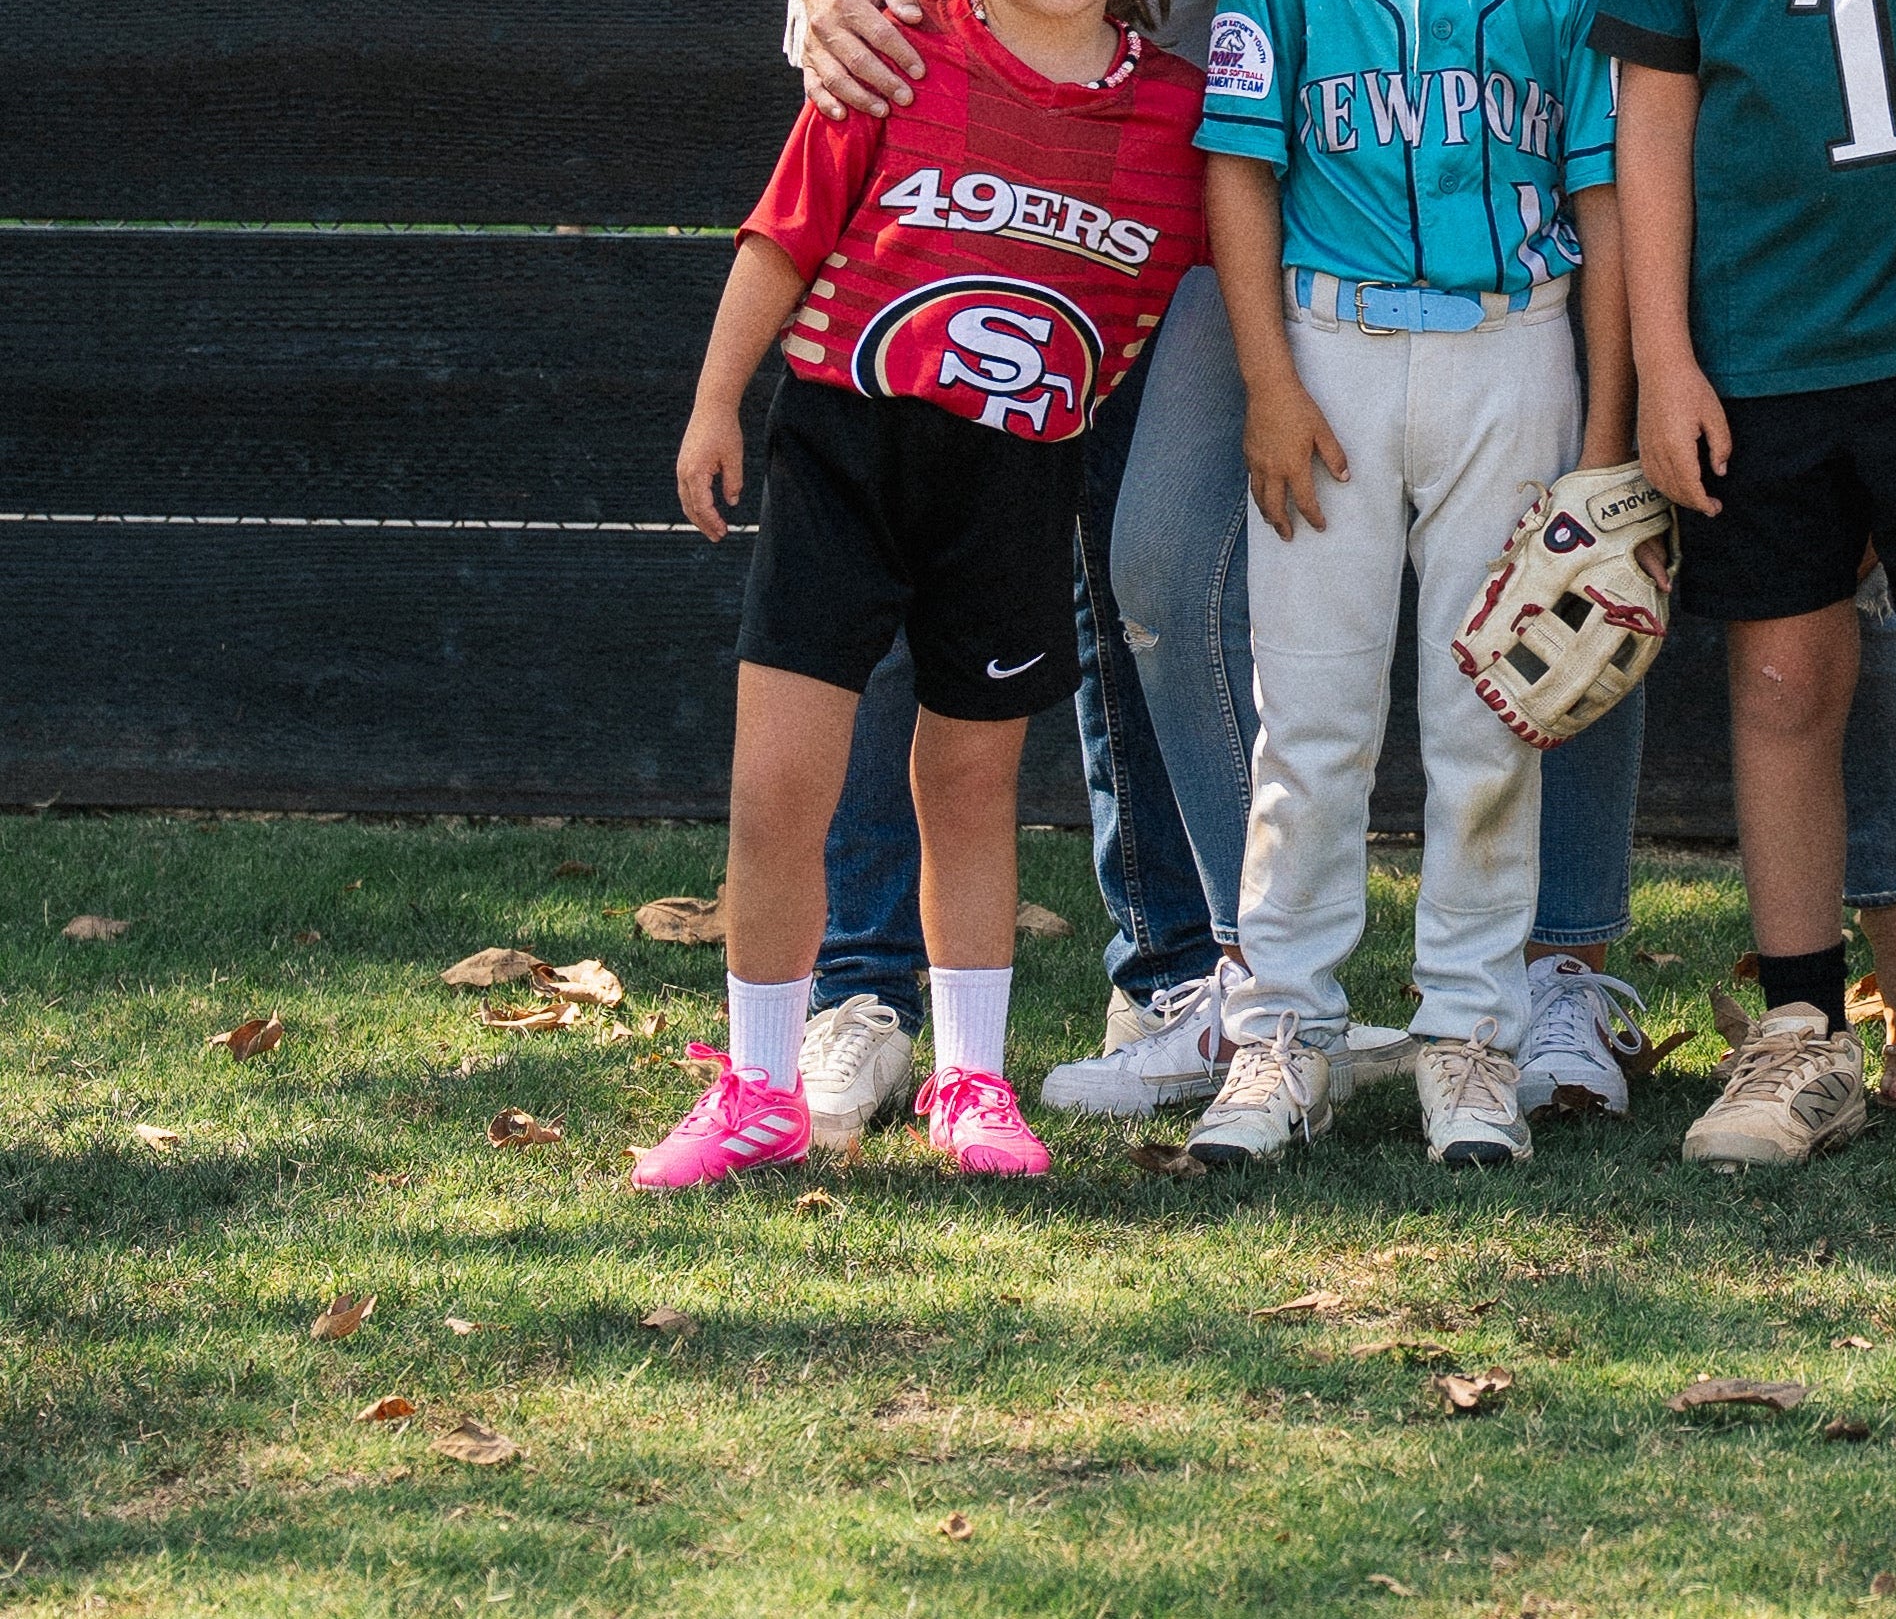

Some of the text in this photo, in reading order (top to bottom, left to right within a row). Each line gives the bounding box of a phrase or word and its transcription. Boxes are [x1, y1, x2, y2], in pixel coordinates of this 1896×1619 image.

[1209, 51, 1244, 67] PONY
[1254, 36, 1266, 63] YOUTH
[1229, 69, 1264, 81] SOFTBALL
[1236, 79, 1264, 92] TEAM
[880, 167, 1160, 267] 49ERS
[938, 304, 1075, 434] SF
